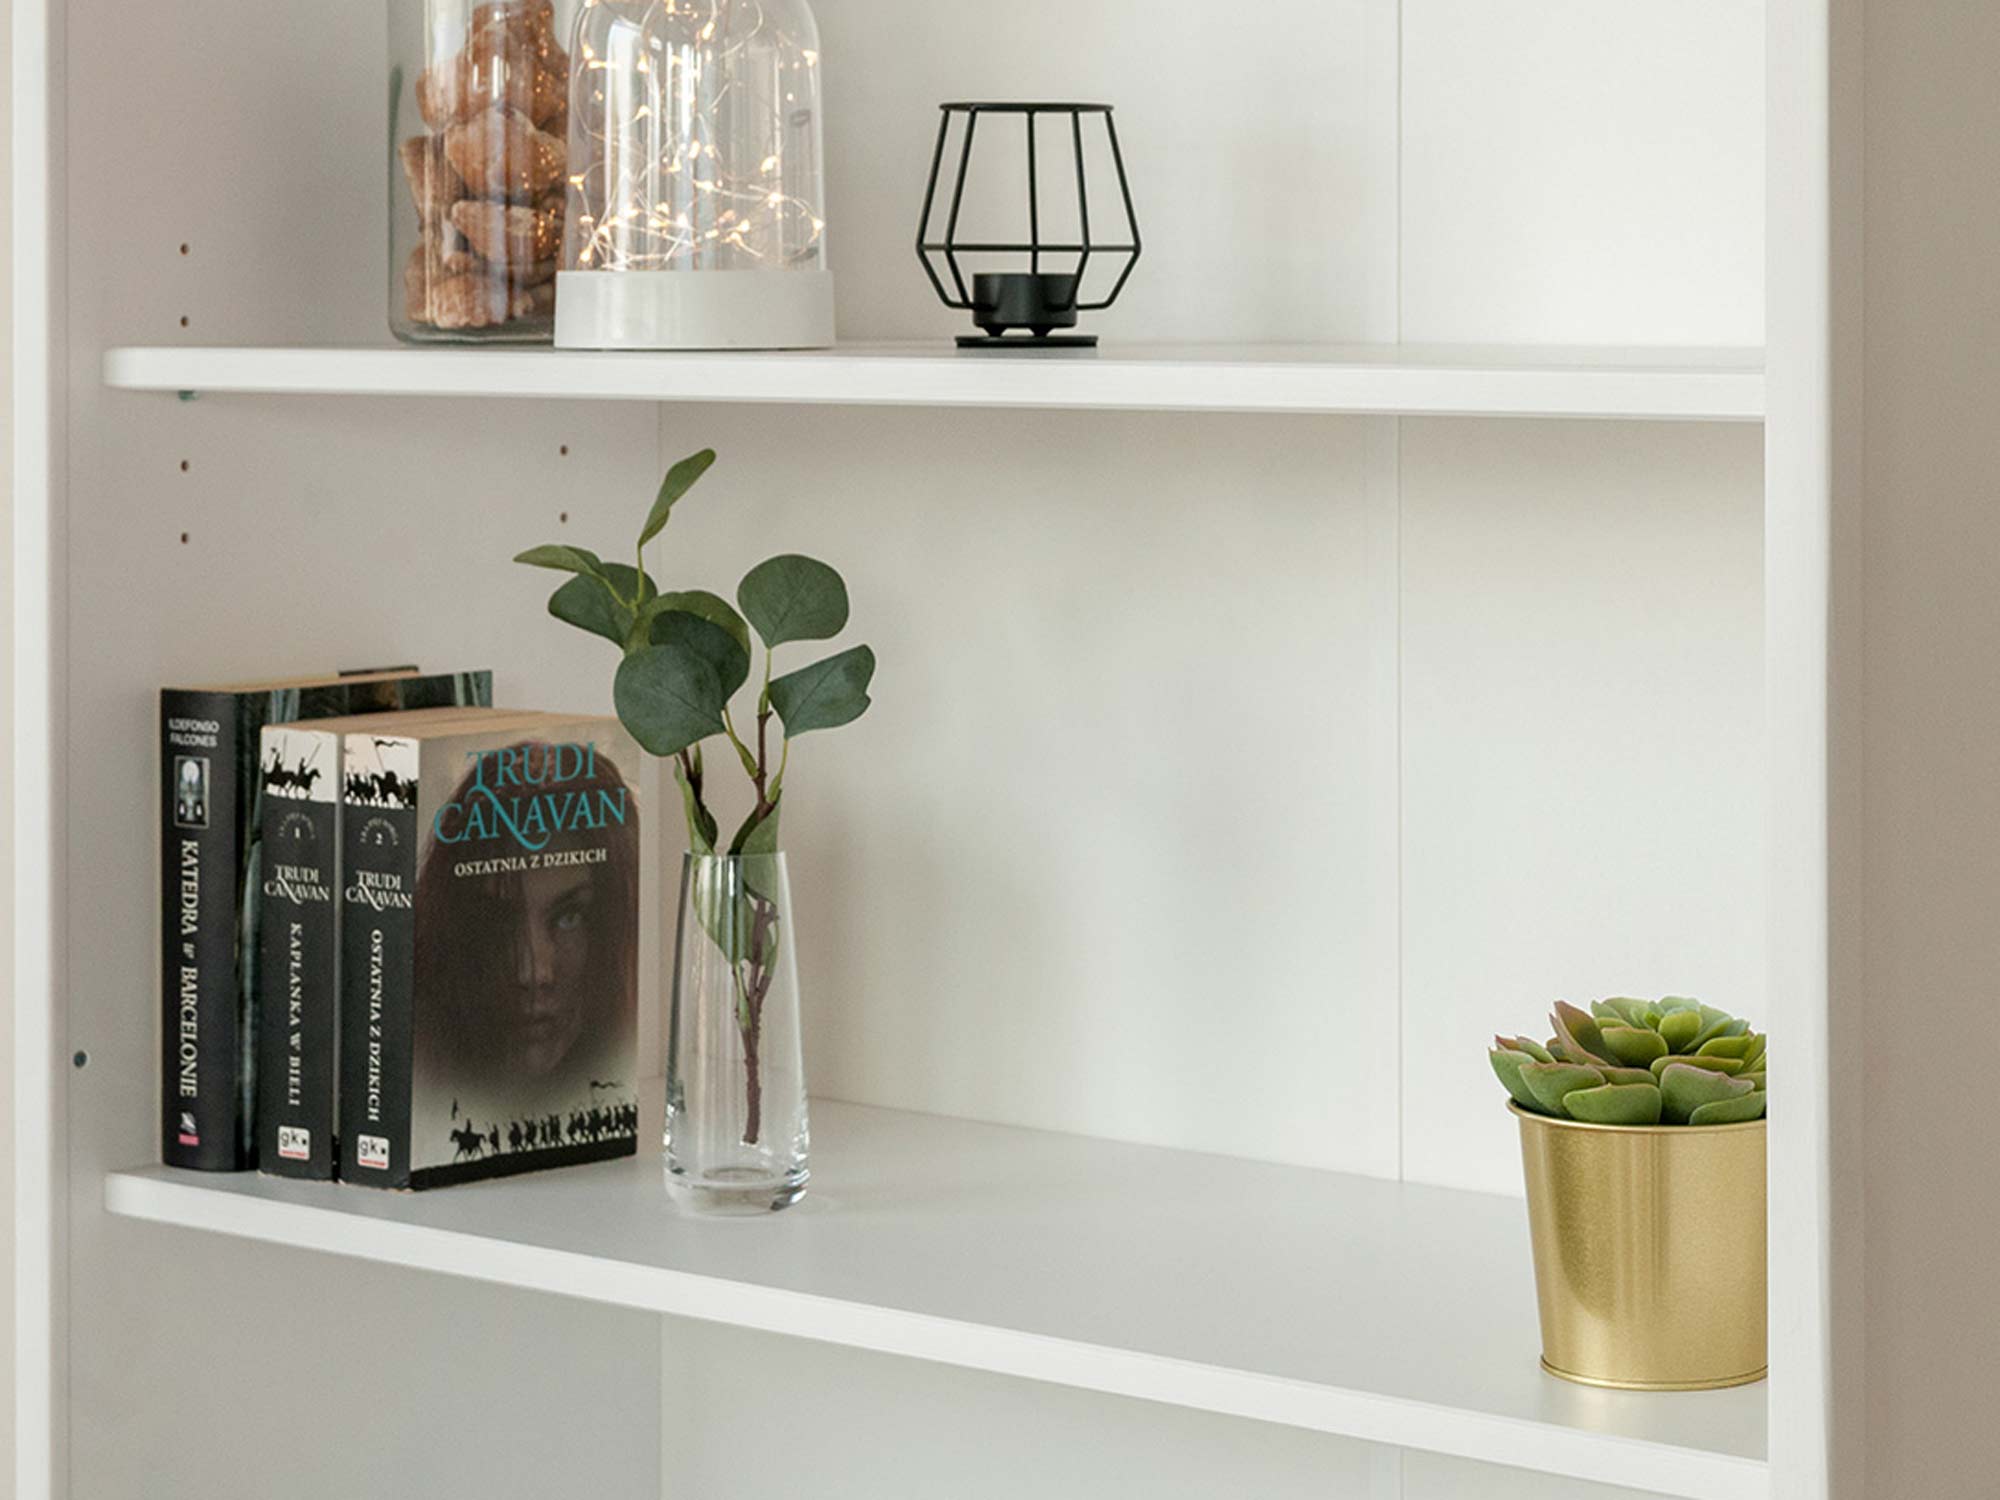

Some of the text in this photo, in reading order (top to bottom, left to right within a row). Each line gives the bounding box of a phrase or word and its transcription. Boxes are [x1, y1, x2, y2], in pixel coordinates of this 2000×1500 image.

[170, 732, 217, 748] FALCONES
[466, 741, 596, 790] TRUDI
[434, 787, 627, 850] CANAVAN
[274, 864, 319, 884] TRUDI
[356, 869, 402, 890] TRUDI
[454, 848, 607, 877] OSTATNIA Z DZIKICH
[181, 839, 199, 935] KATEDRA
[264, 880, 330, 905] CANAVAN
[345, 886, 412, 912] CANAVAN
[179, 965, 198, 1098] BARCELONIE
[368, 928, 383, 1121] OSTATNIA Z DZIKICH
[288, 1055, 301, 1106] BIELI
